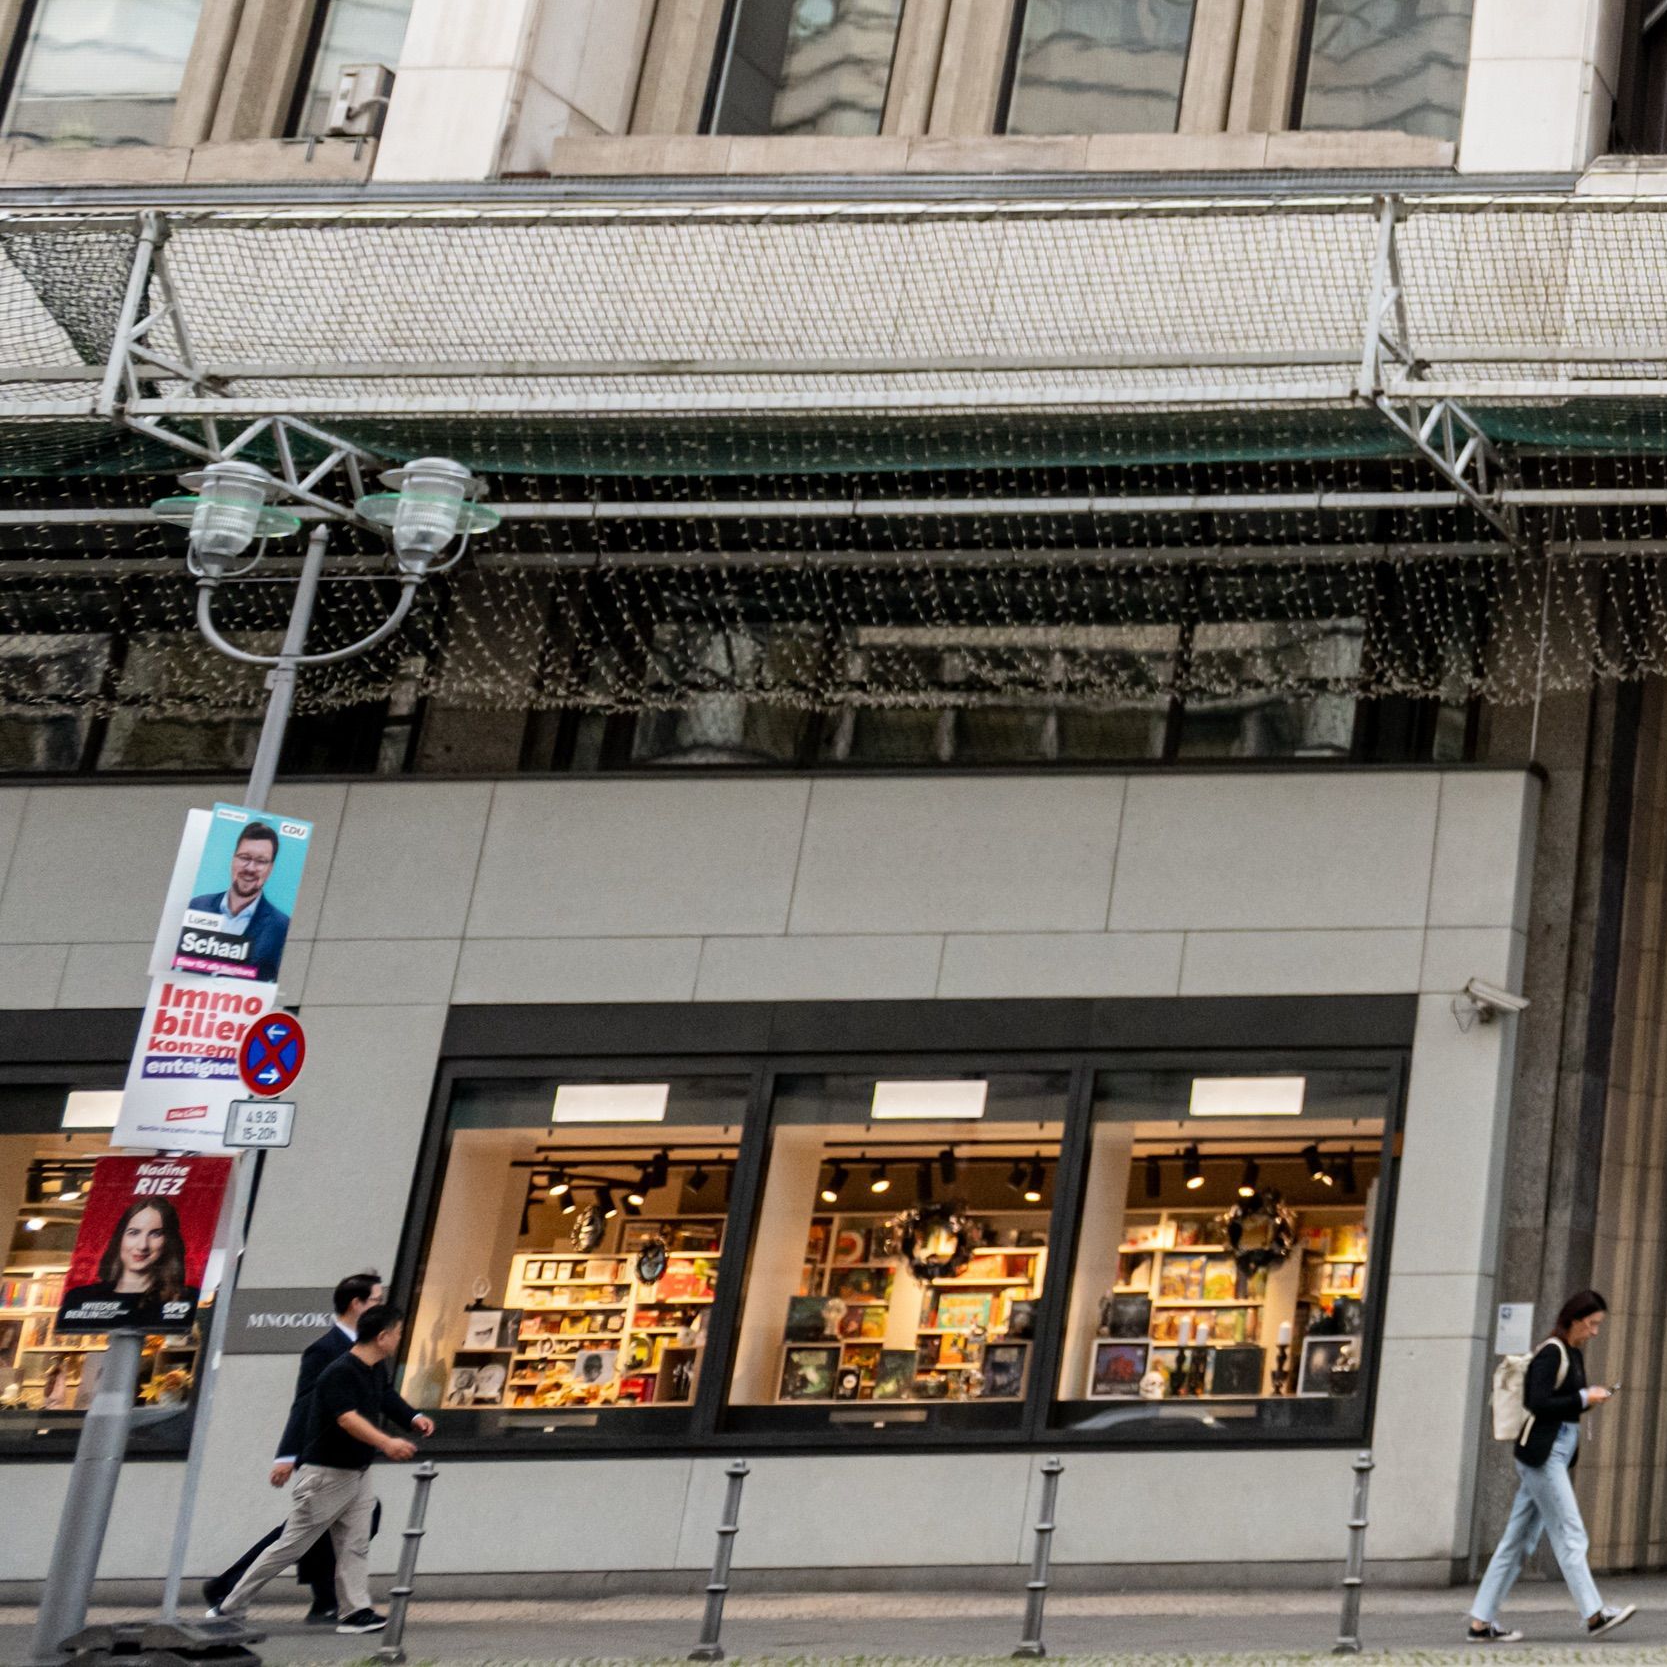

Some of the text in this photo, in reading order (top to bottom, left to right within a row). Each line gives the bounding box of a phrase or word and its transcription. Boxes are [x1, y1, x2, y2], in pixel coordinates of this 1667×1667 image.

[281, 823, 306, 837] CDU
[187, 913, 220, 928] Lucas
[180, 931, 250, 961] Schaal
[159, 983, 263, 1017] Immo
[136, 1164, 192, 1177] Nadine
[133, 1177, 188, 1195] RIEZ
[80, 1301, 122, 1311] WIEDER
[162, 1301, 190, 1314] SPD
[63, 1310, 100, 1320] BERLIN
